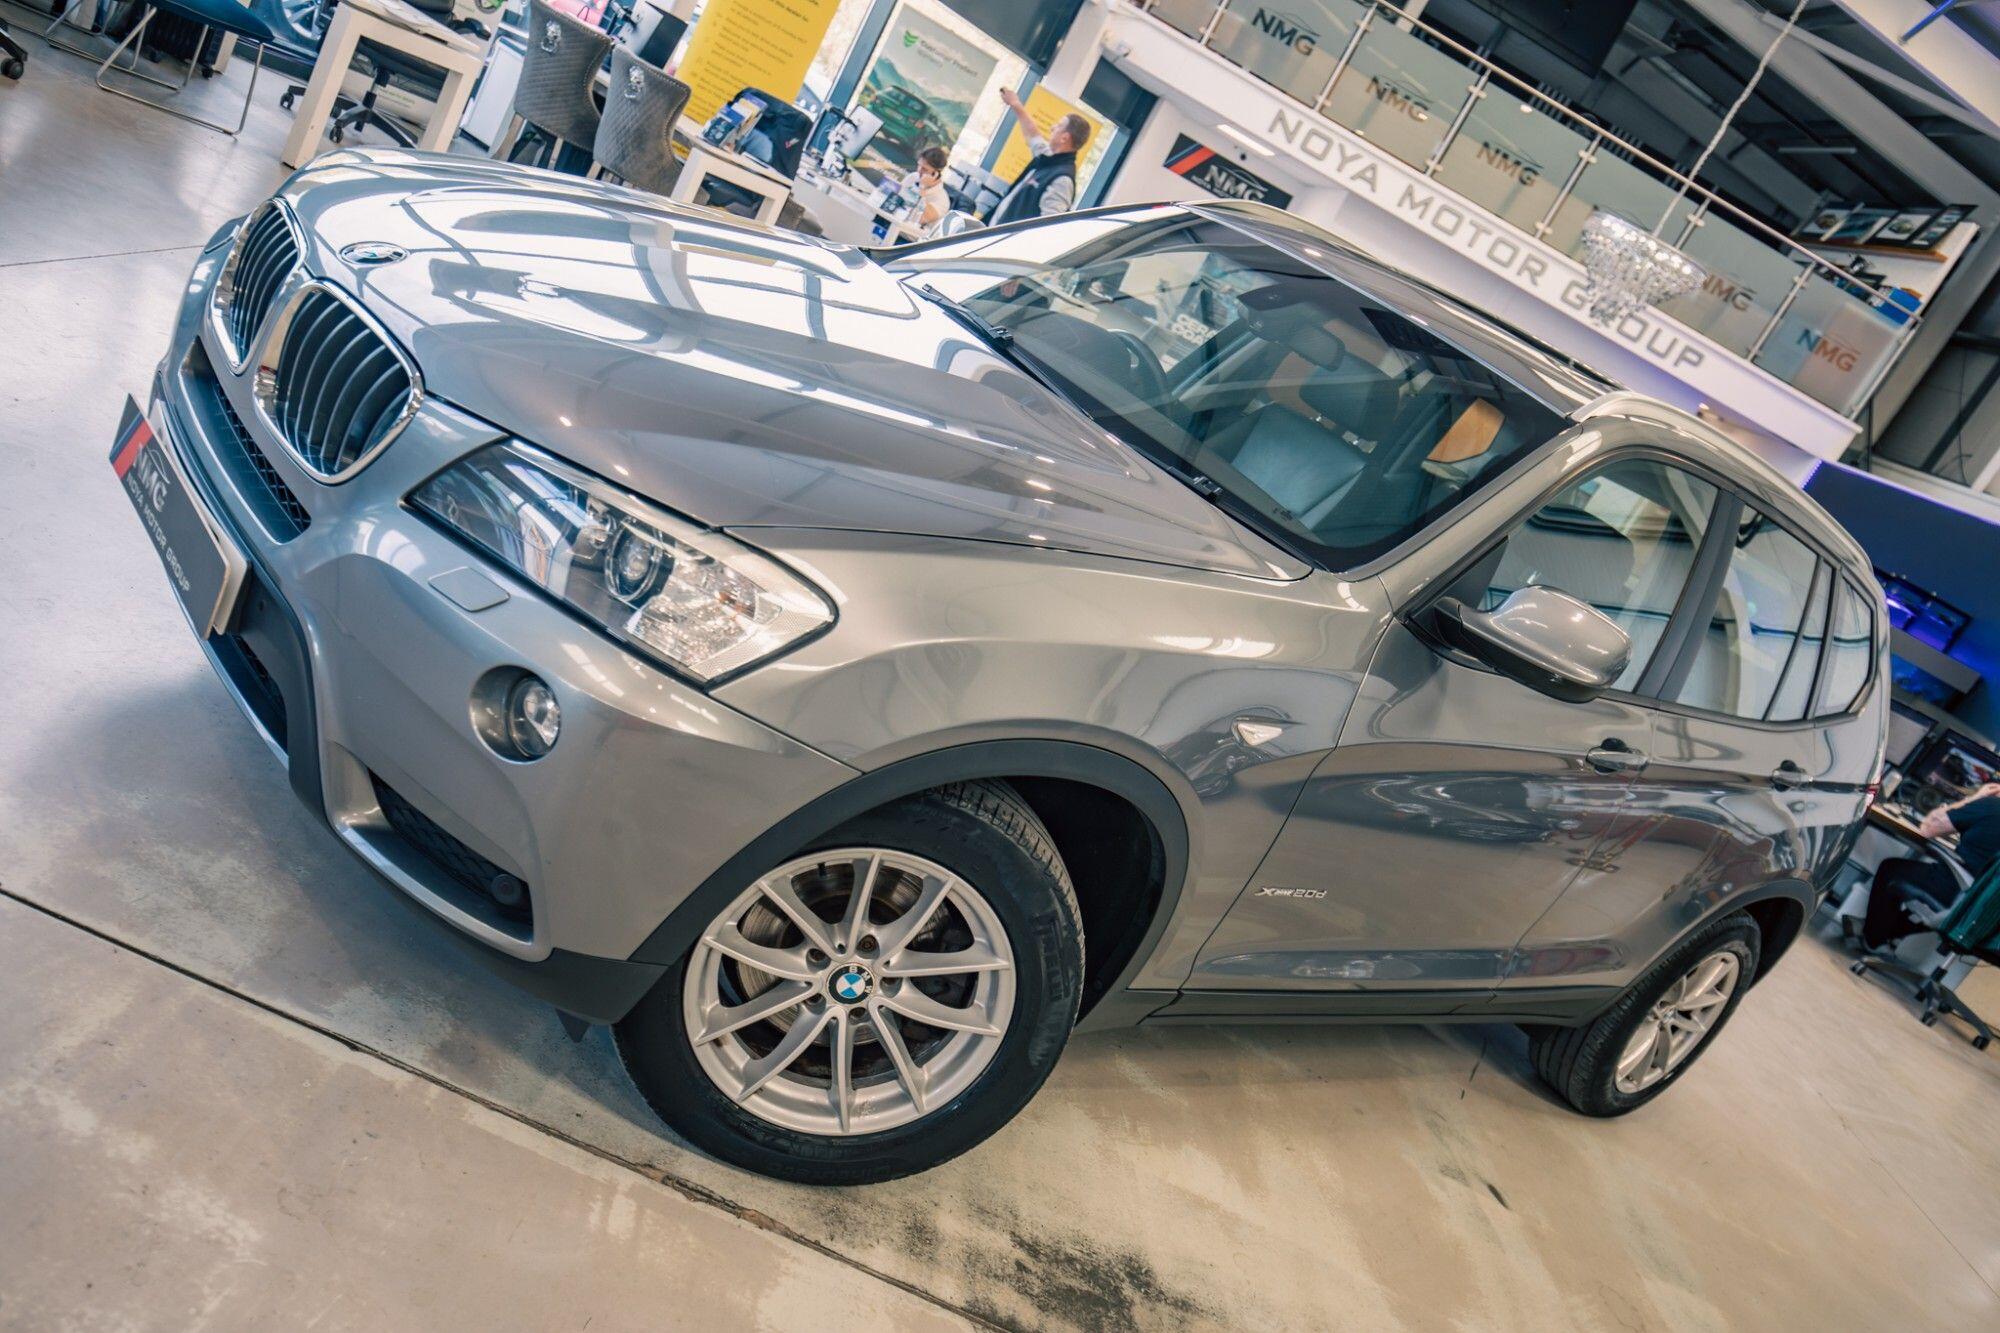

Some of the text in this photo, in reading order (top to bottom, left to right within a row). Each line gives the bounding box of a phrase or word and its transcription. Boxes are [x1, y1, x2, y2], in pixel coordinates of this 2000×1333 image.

[1252, 7, 1316, 56] NMG
[1365, 75, 1429, 122] NMG
[1476, 141, 1539, 186] NMG
[1268, 108, 1380, 193] NOYA
[1397, 183, 1548, 286] MOTOR
[1796, 328, 1857, 372] NMG
[133, 442, 168, 512] NMG
[126, 472, 191, 592] NOYA MOTOR GROUP
